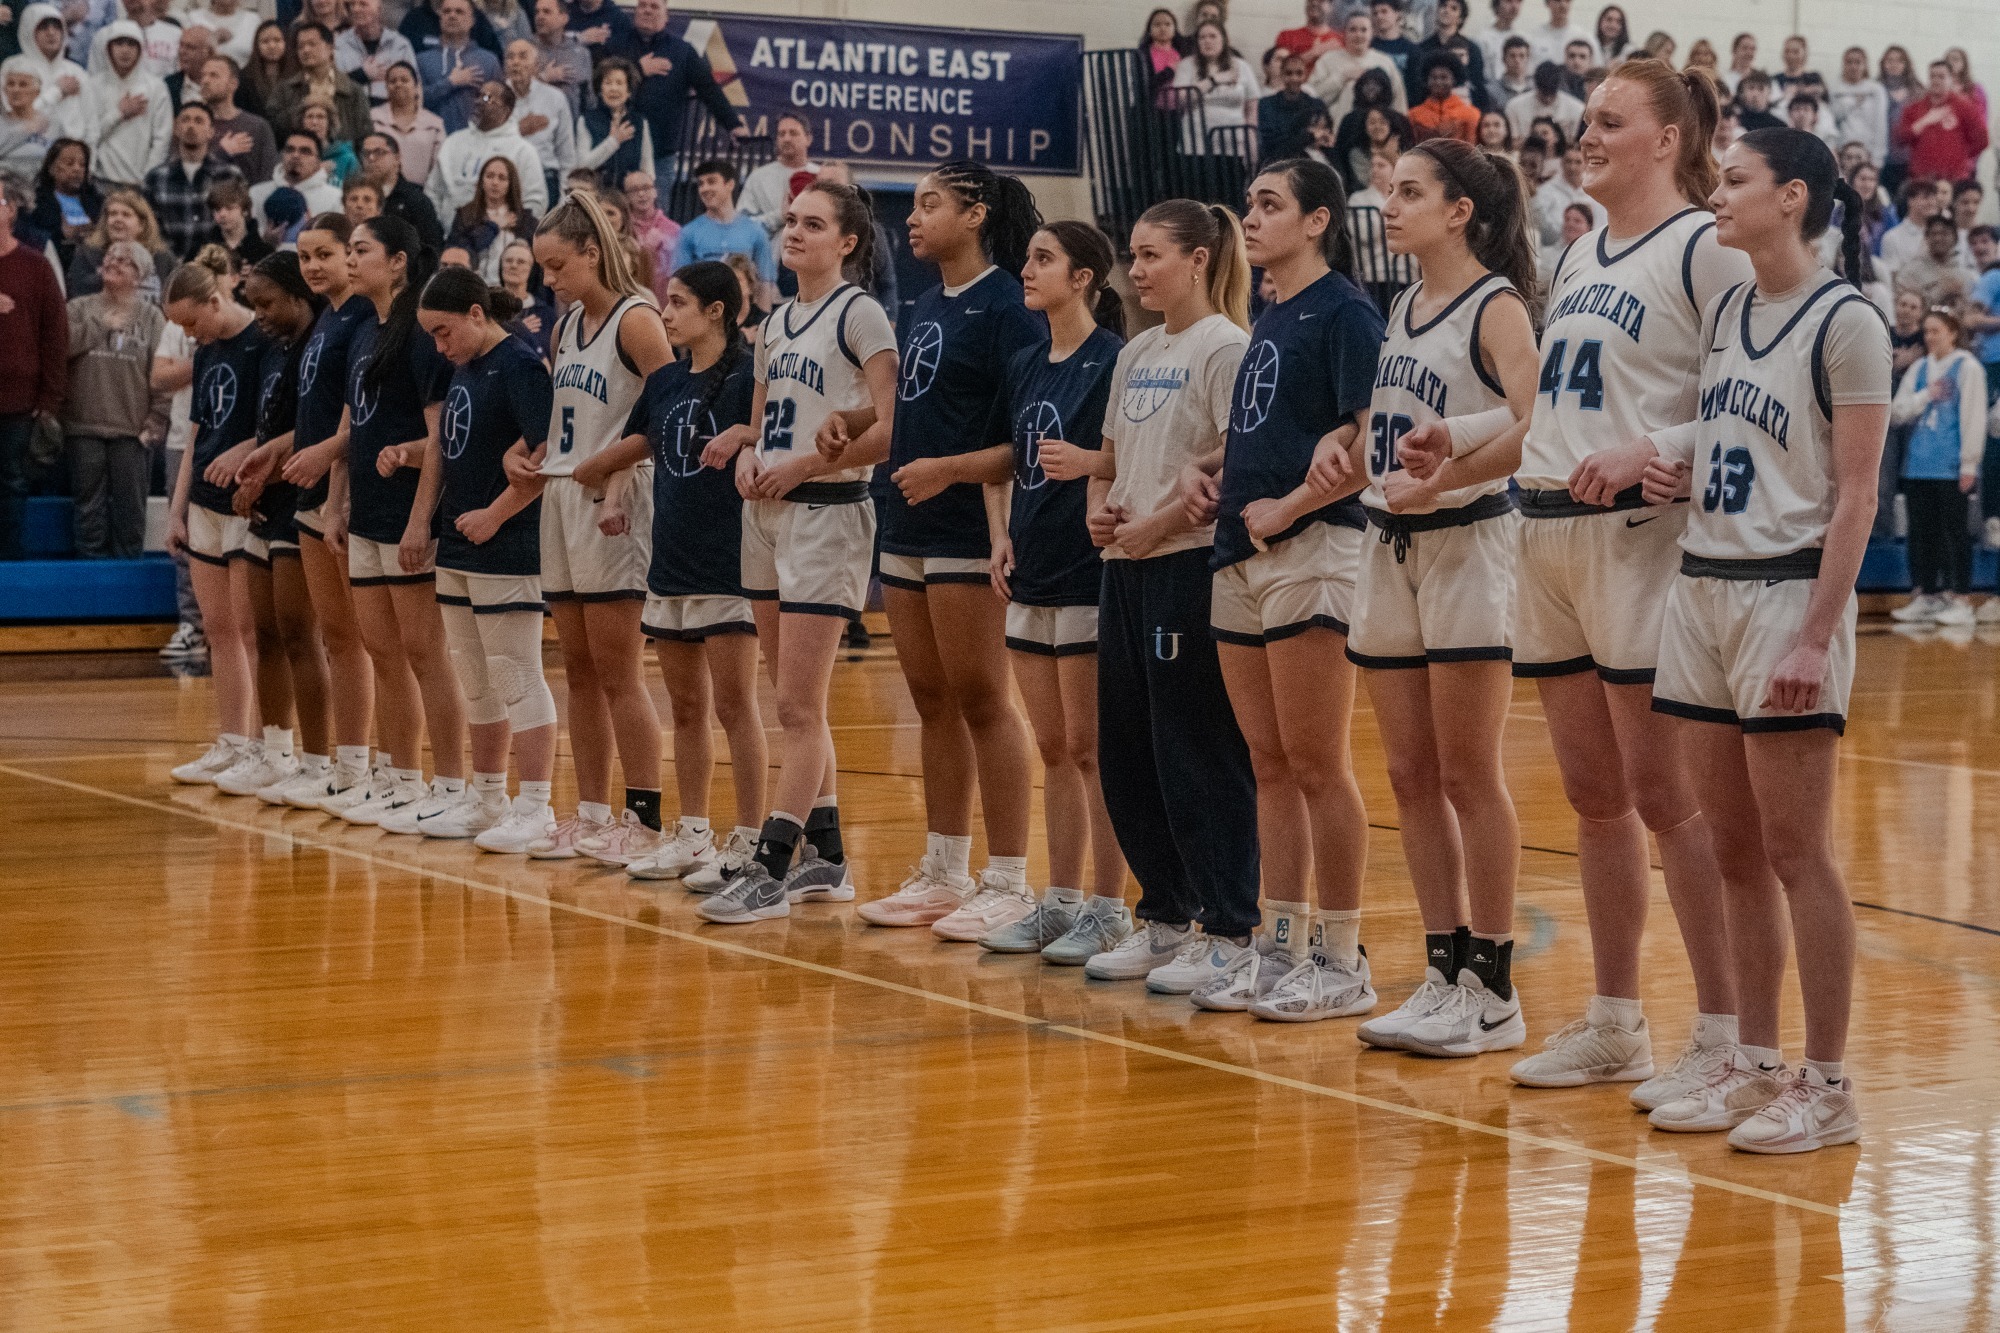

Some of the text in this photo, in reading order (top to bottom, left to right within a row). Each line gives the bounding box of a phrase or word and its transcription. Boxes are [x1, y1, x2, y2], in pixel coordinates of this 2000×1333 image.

[750, 36, 1011, 82] ATLANTIC EAST
[790, 79, 973, 116] CONFERENCE
[1537, 338, 1604, 412] 44
[559, 405, 575, 455] 5
[763, 396, 798, 452] 22
[1370, 411, 1416, 478] 30
[1703, 440, 1756, 515] 33
